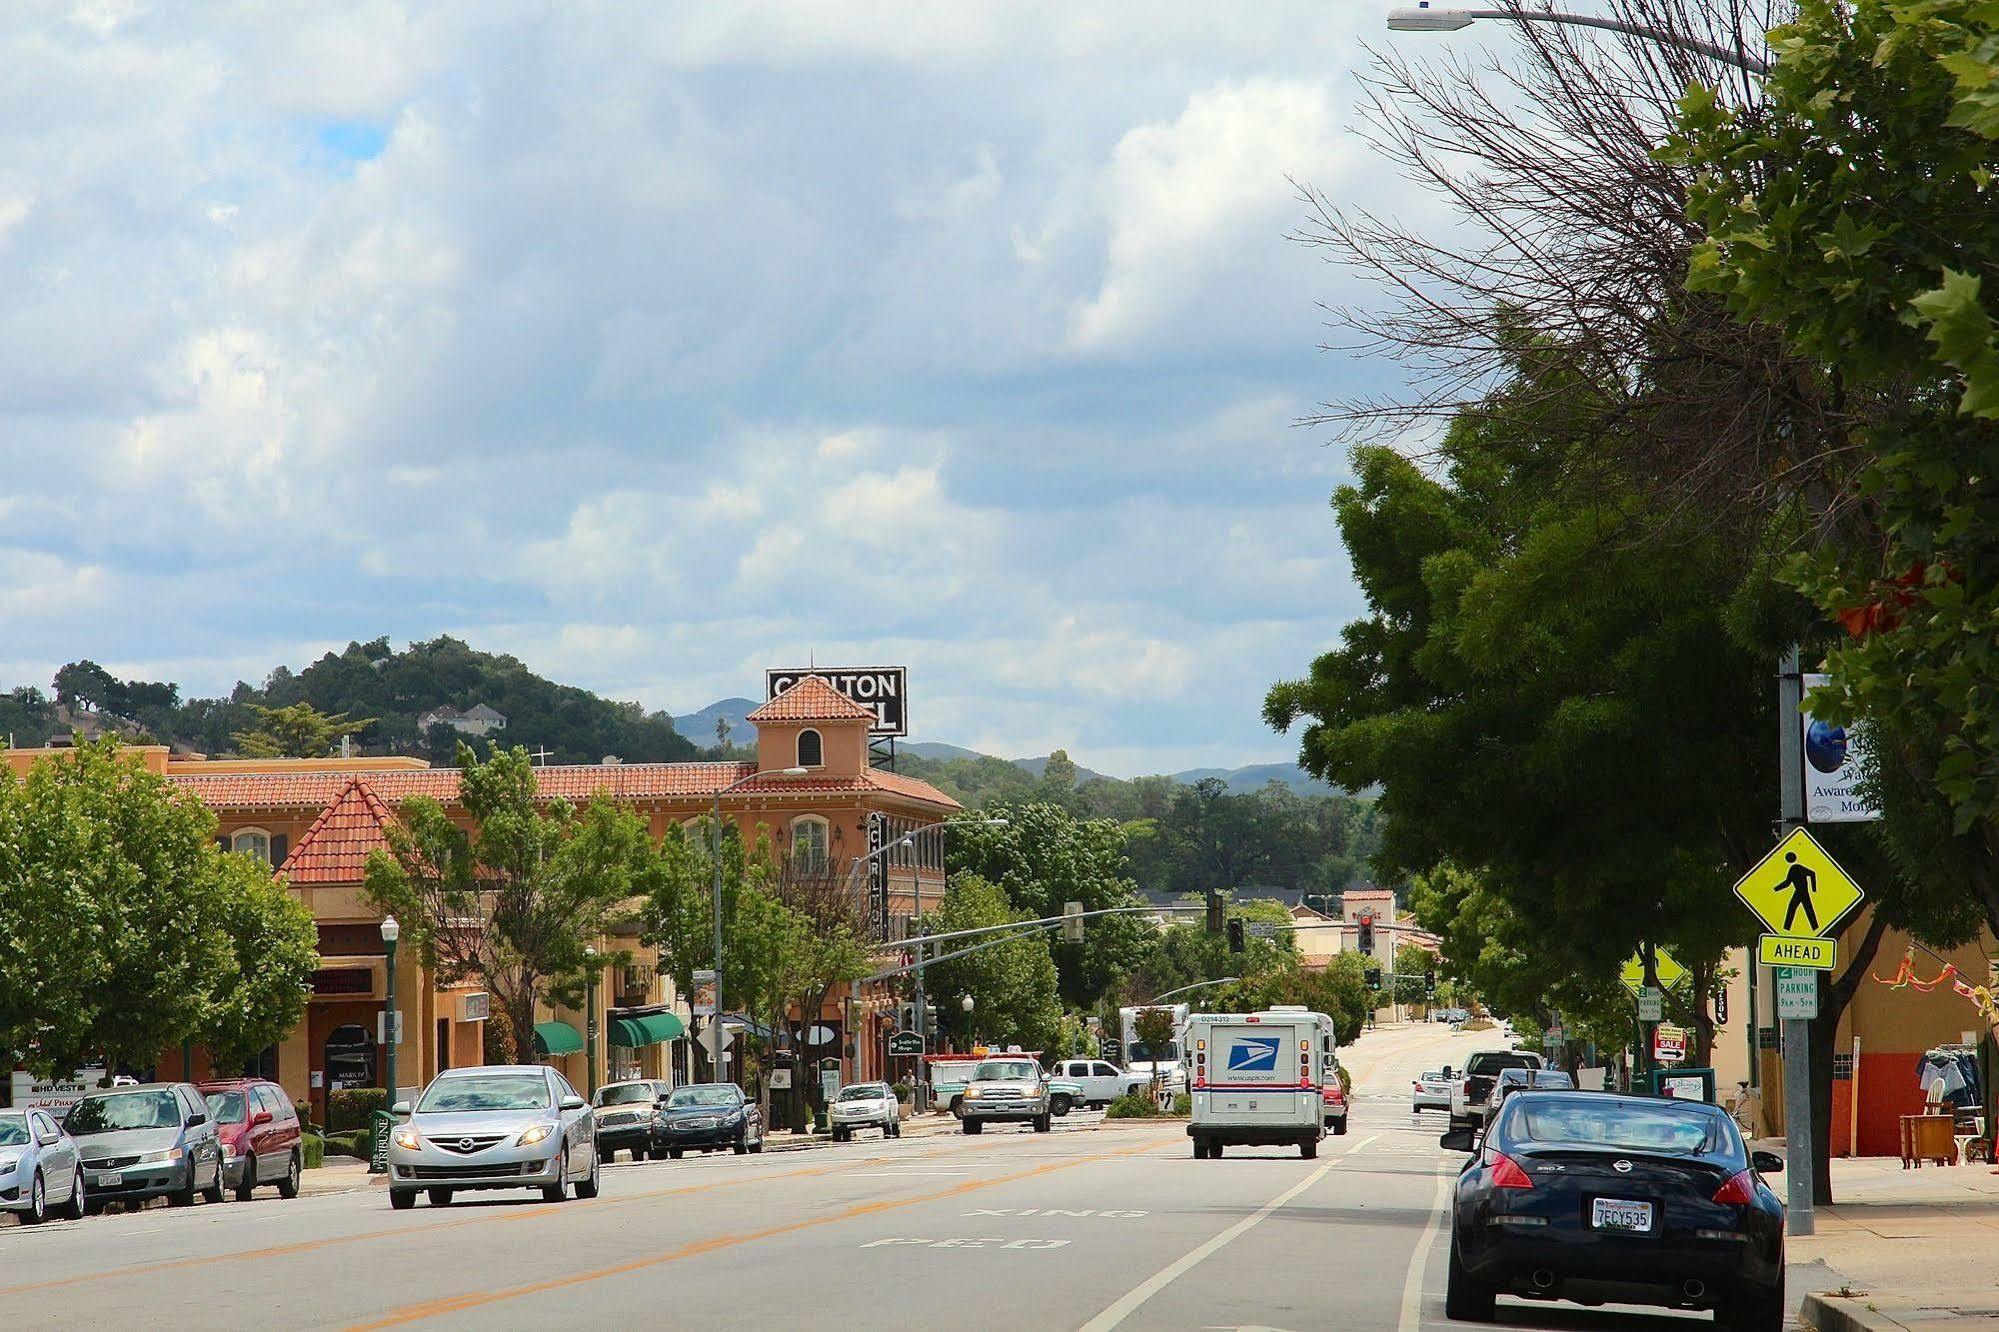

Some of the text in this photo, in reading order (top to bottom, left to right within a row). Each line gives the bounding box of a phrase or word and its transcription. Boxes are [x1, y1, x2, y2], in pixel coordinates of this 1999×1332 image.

[1775, 944, 1821, 960] AHEAD
[1780, 983, 1814, 994] PARKING
[1660, 1041, 1681, 1049] SALE
[55, 1084, 76, 1092] VEST
[377, 1118, 389, 1170] TRIBUNE
[960, 1209, 1150, 1217] XING
[1598, 1209, 1647, 1226] 7ECY535
[859, 1239, 1072, 1248] PED
